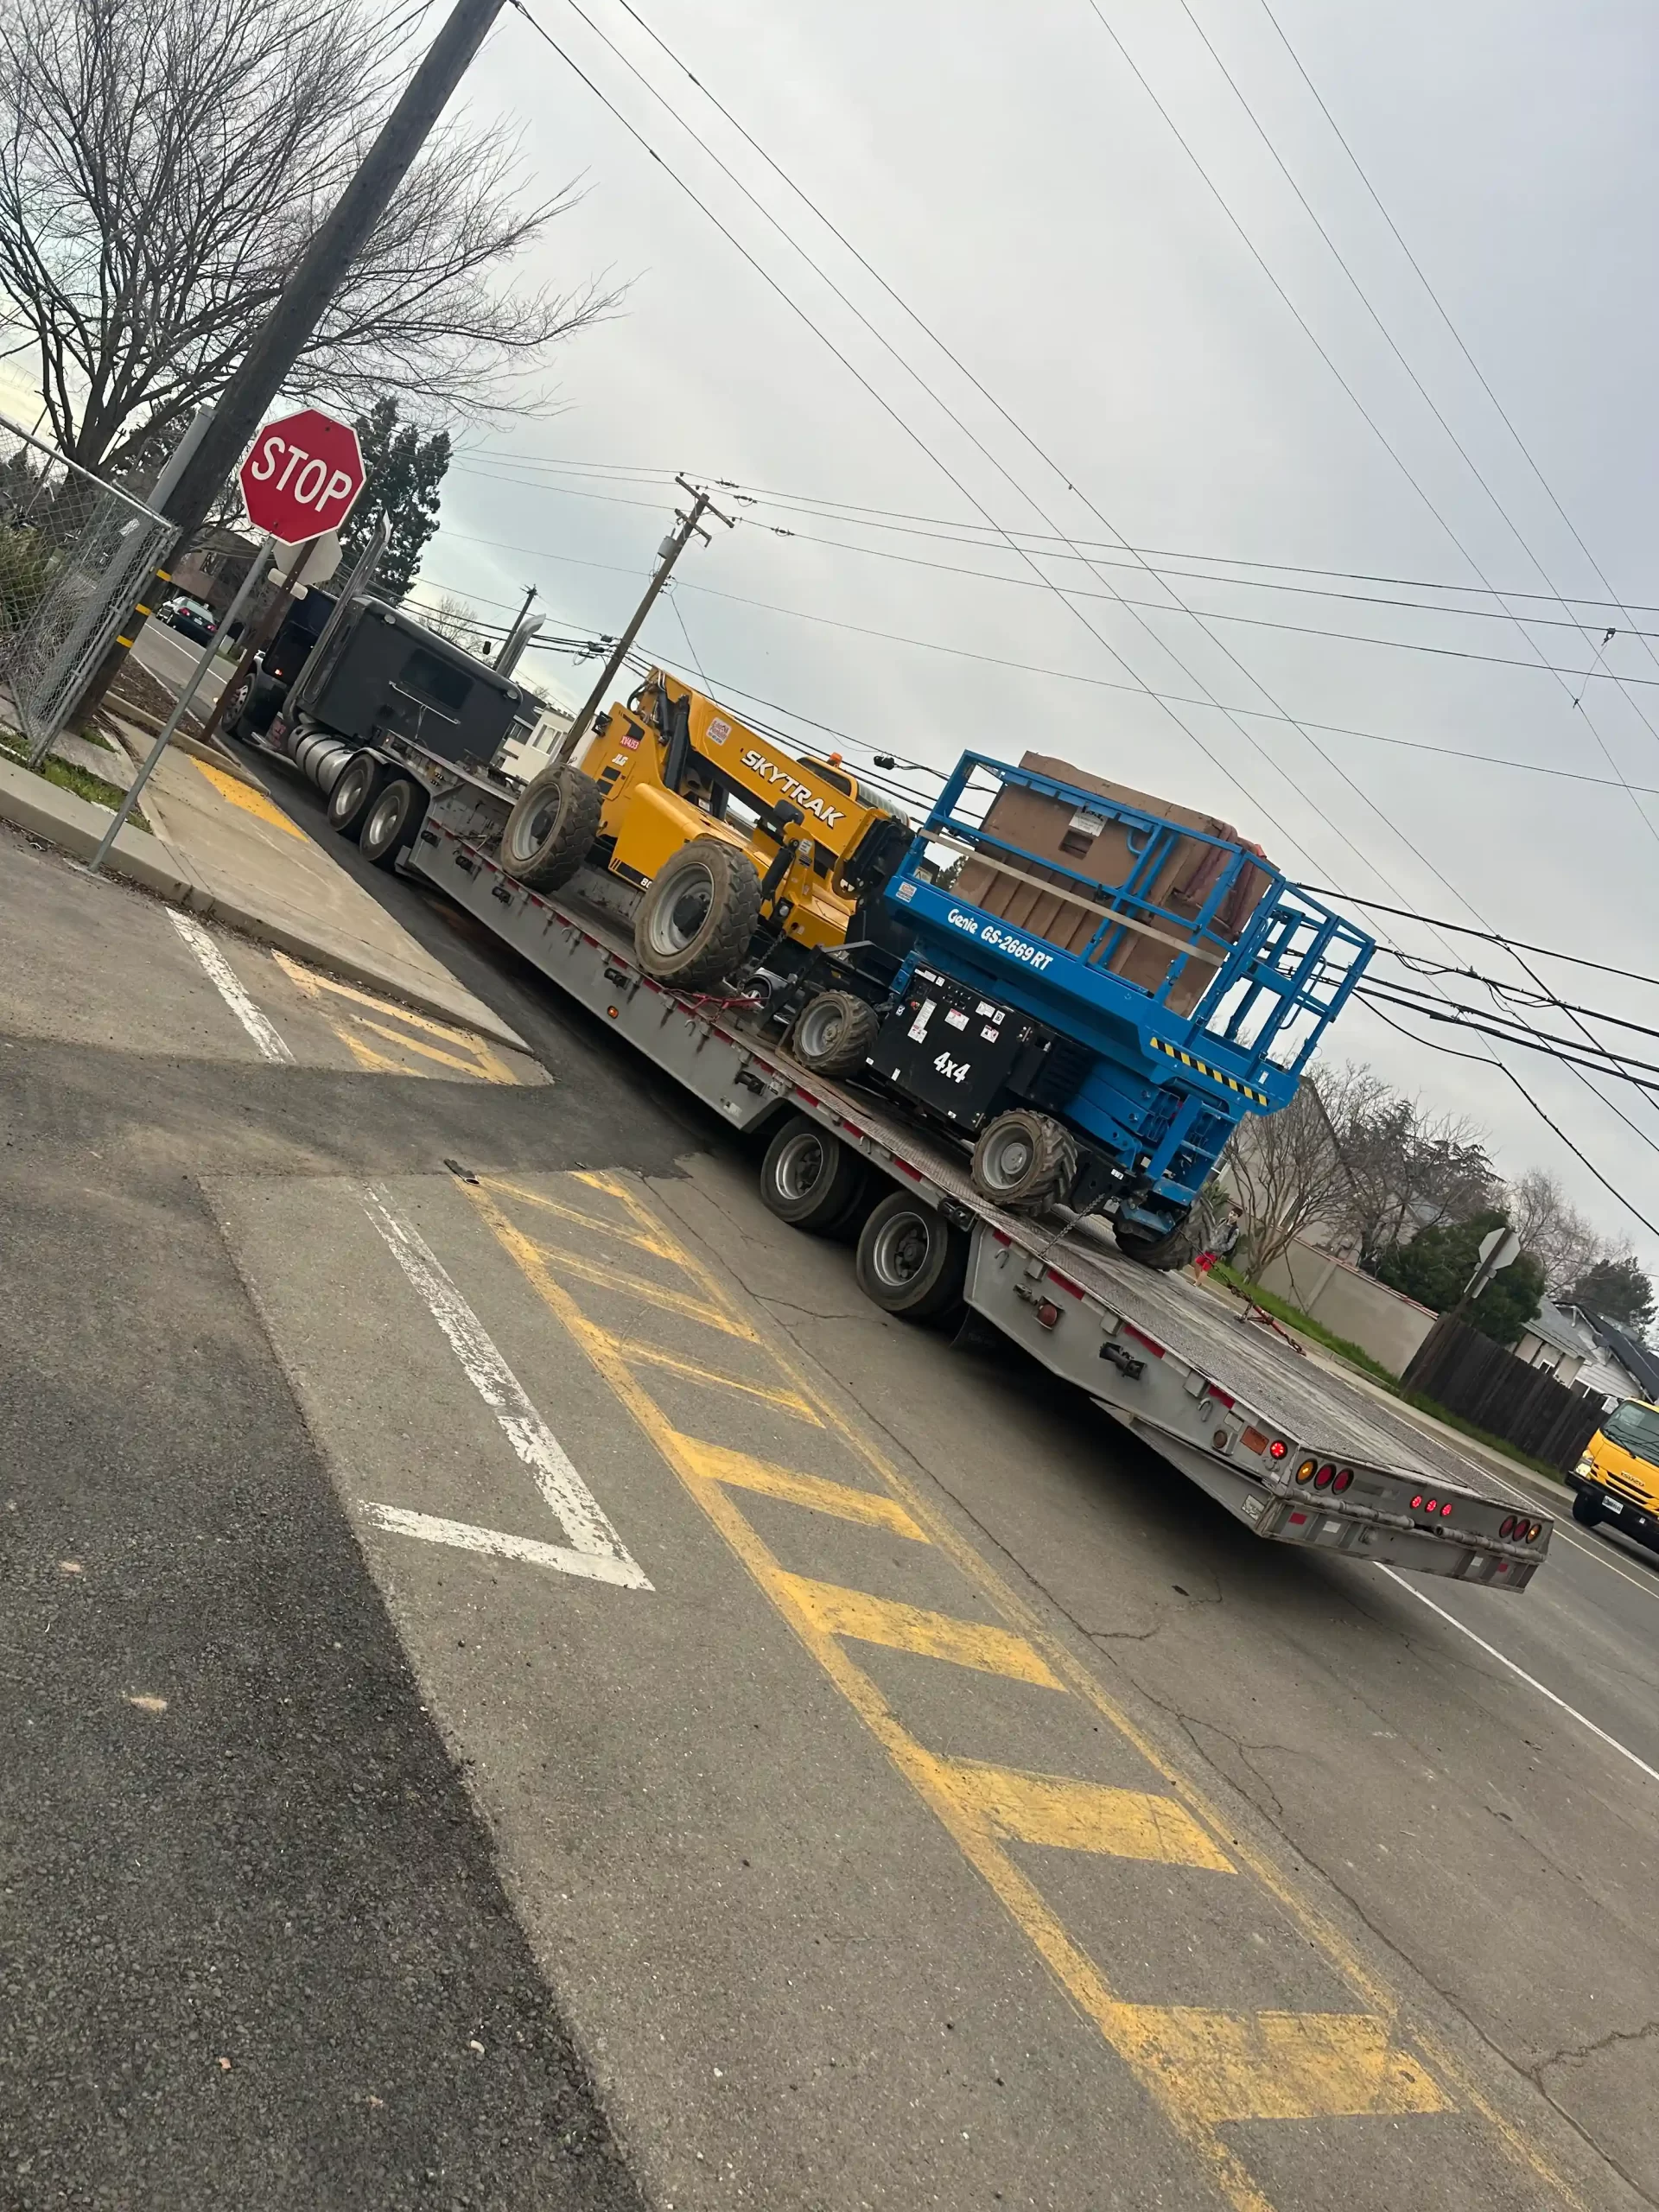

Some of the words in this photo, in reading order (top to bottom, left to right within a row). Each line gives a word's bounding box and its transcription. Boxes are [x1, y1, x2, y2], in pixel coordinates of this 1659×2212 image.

[251, 436, 353, 512] STOP
[612, 753, 629, 766] JLG
[741, 750, 847, 830] SKYTRAK
[947, 908, 978, 934] Genie
[933, 1052, 971, 1084] 4x4
